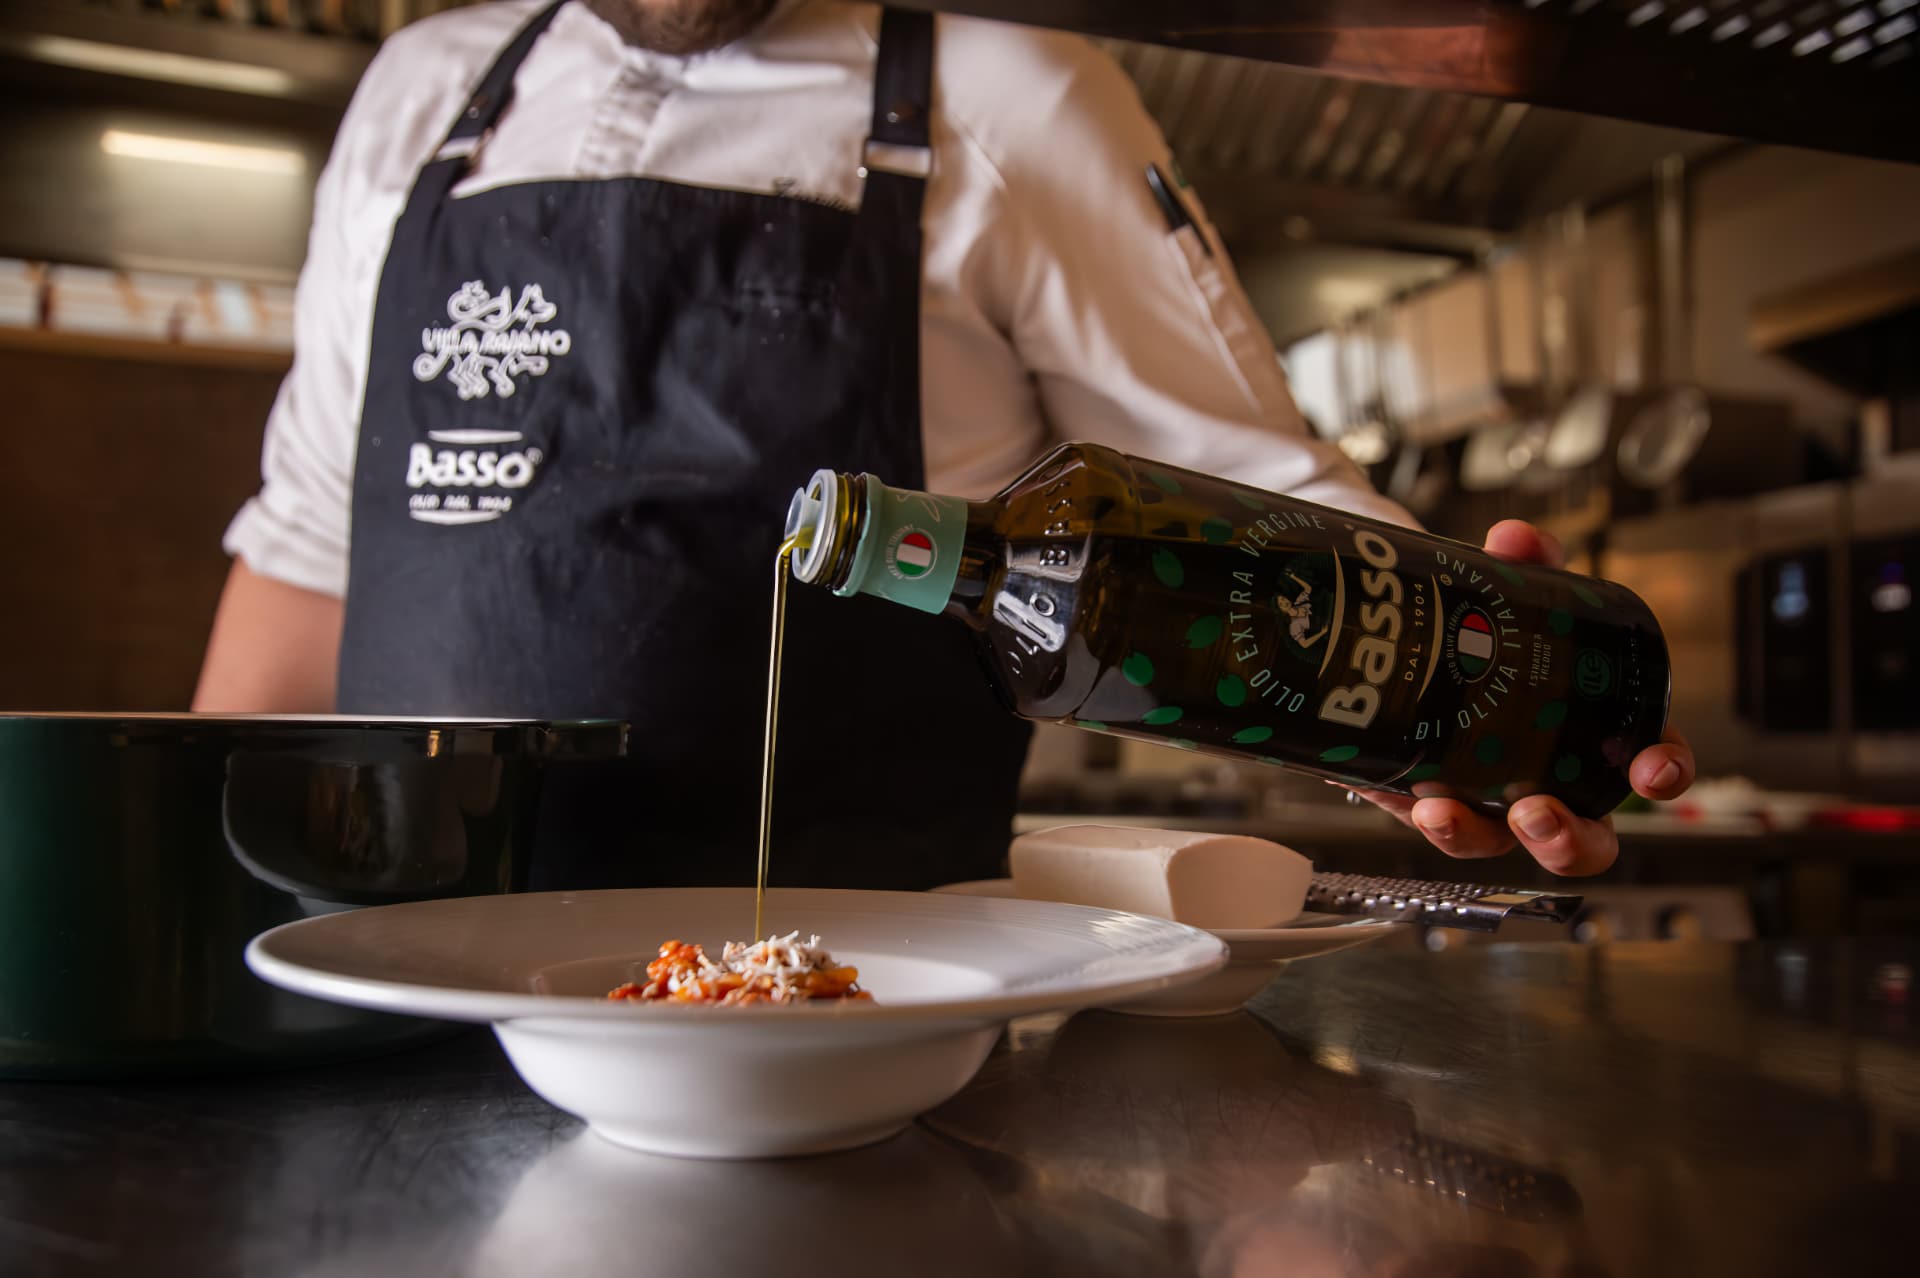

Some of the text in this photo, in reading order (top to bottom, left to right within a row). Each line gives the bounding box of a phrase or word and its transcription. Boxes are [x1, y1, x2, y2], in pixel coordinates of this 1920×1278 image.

[406, 443, 534, 488] Basso
[1229, 511, 1326, 713] OLIO EXTRA VERGINE
[1318, 529, 1404, 730] Basso
[1403, 583, 1425, 683] DAL 1904
[1414, 550, 1521, 741] DI OLIVA ITALIANO
